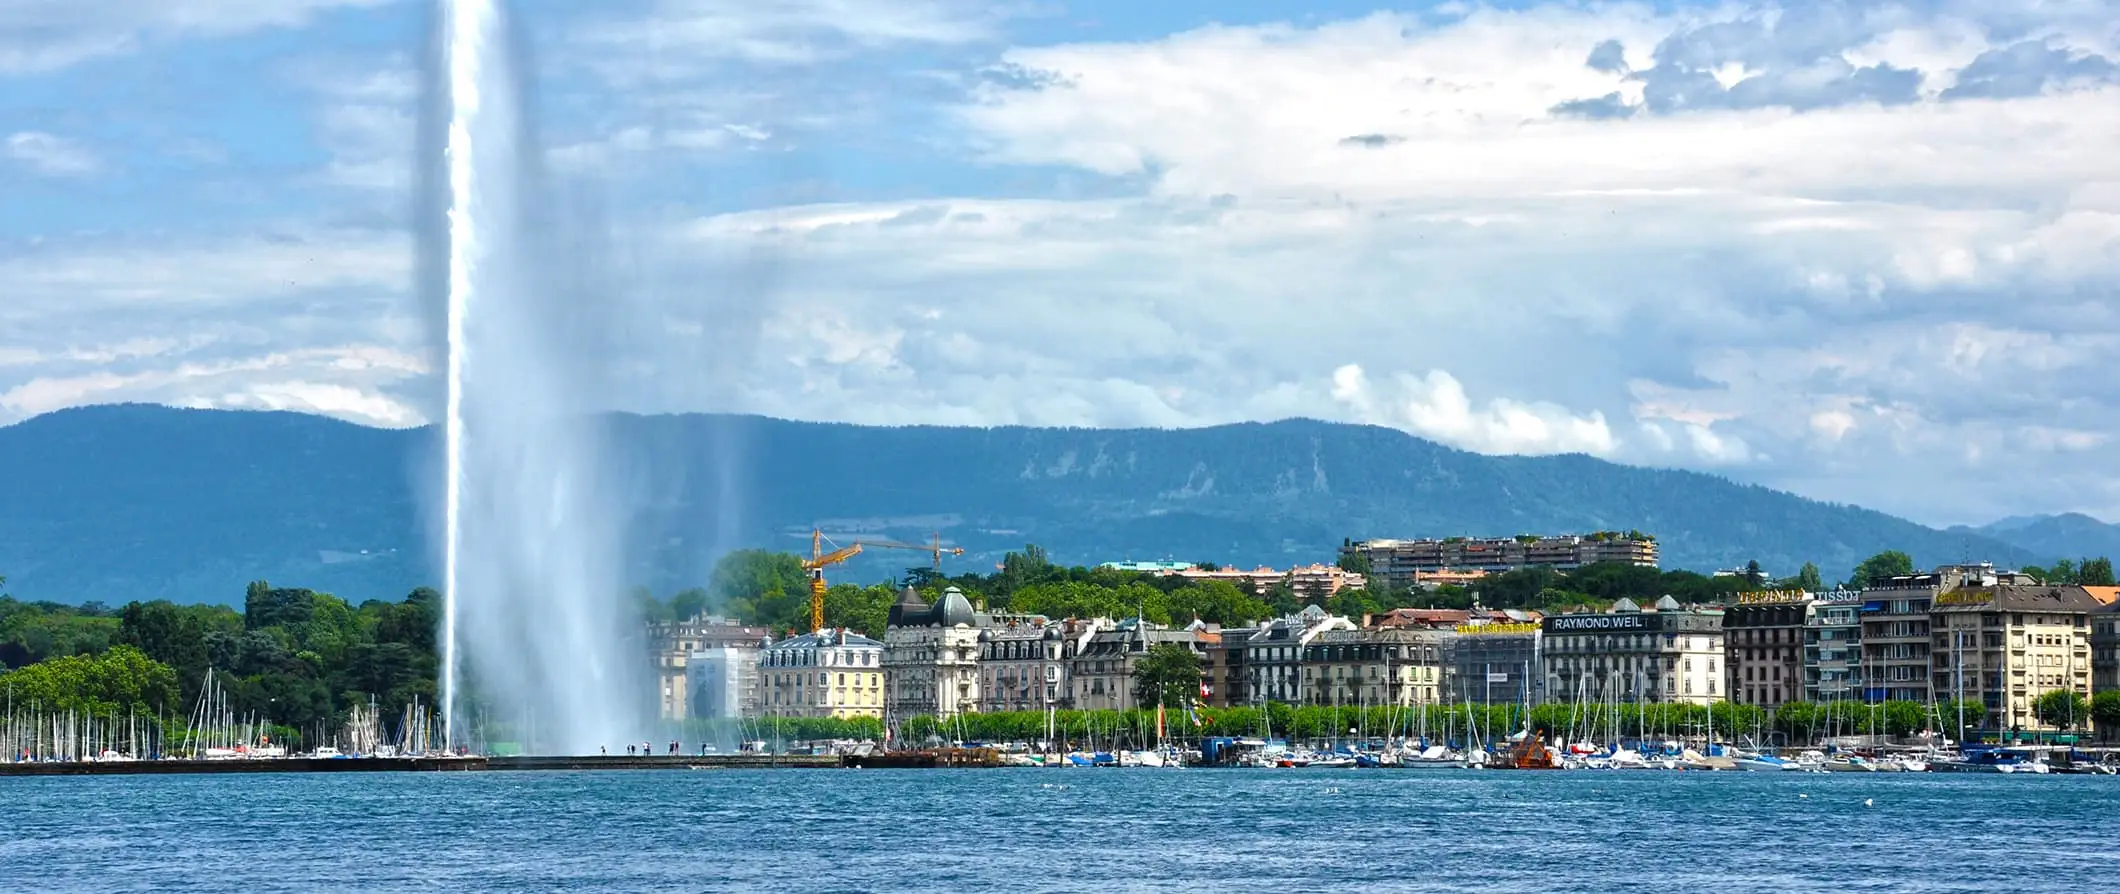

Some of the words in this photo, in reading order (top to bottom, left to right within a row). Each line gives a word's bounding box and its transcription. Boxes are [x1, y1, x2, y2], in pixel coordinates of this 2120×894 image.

[1815, 589, 1861, 602] TISSOT
[1555, 617, 1609, 630] RAYMOND
[1613, 616, 1642, 628] WEIL
